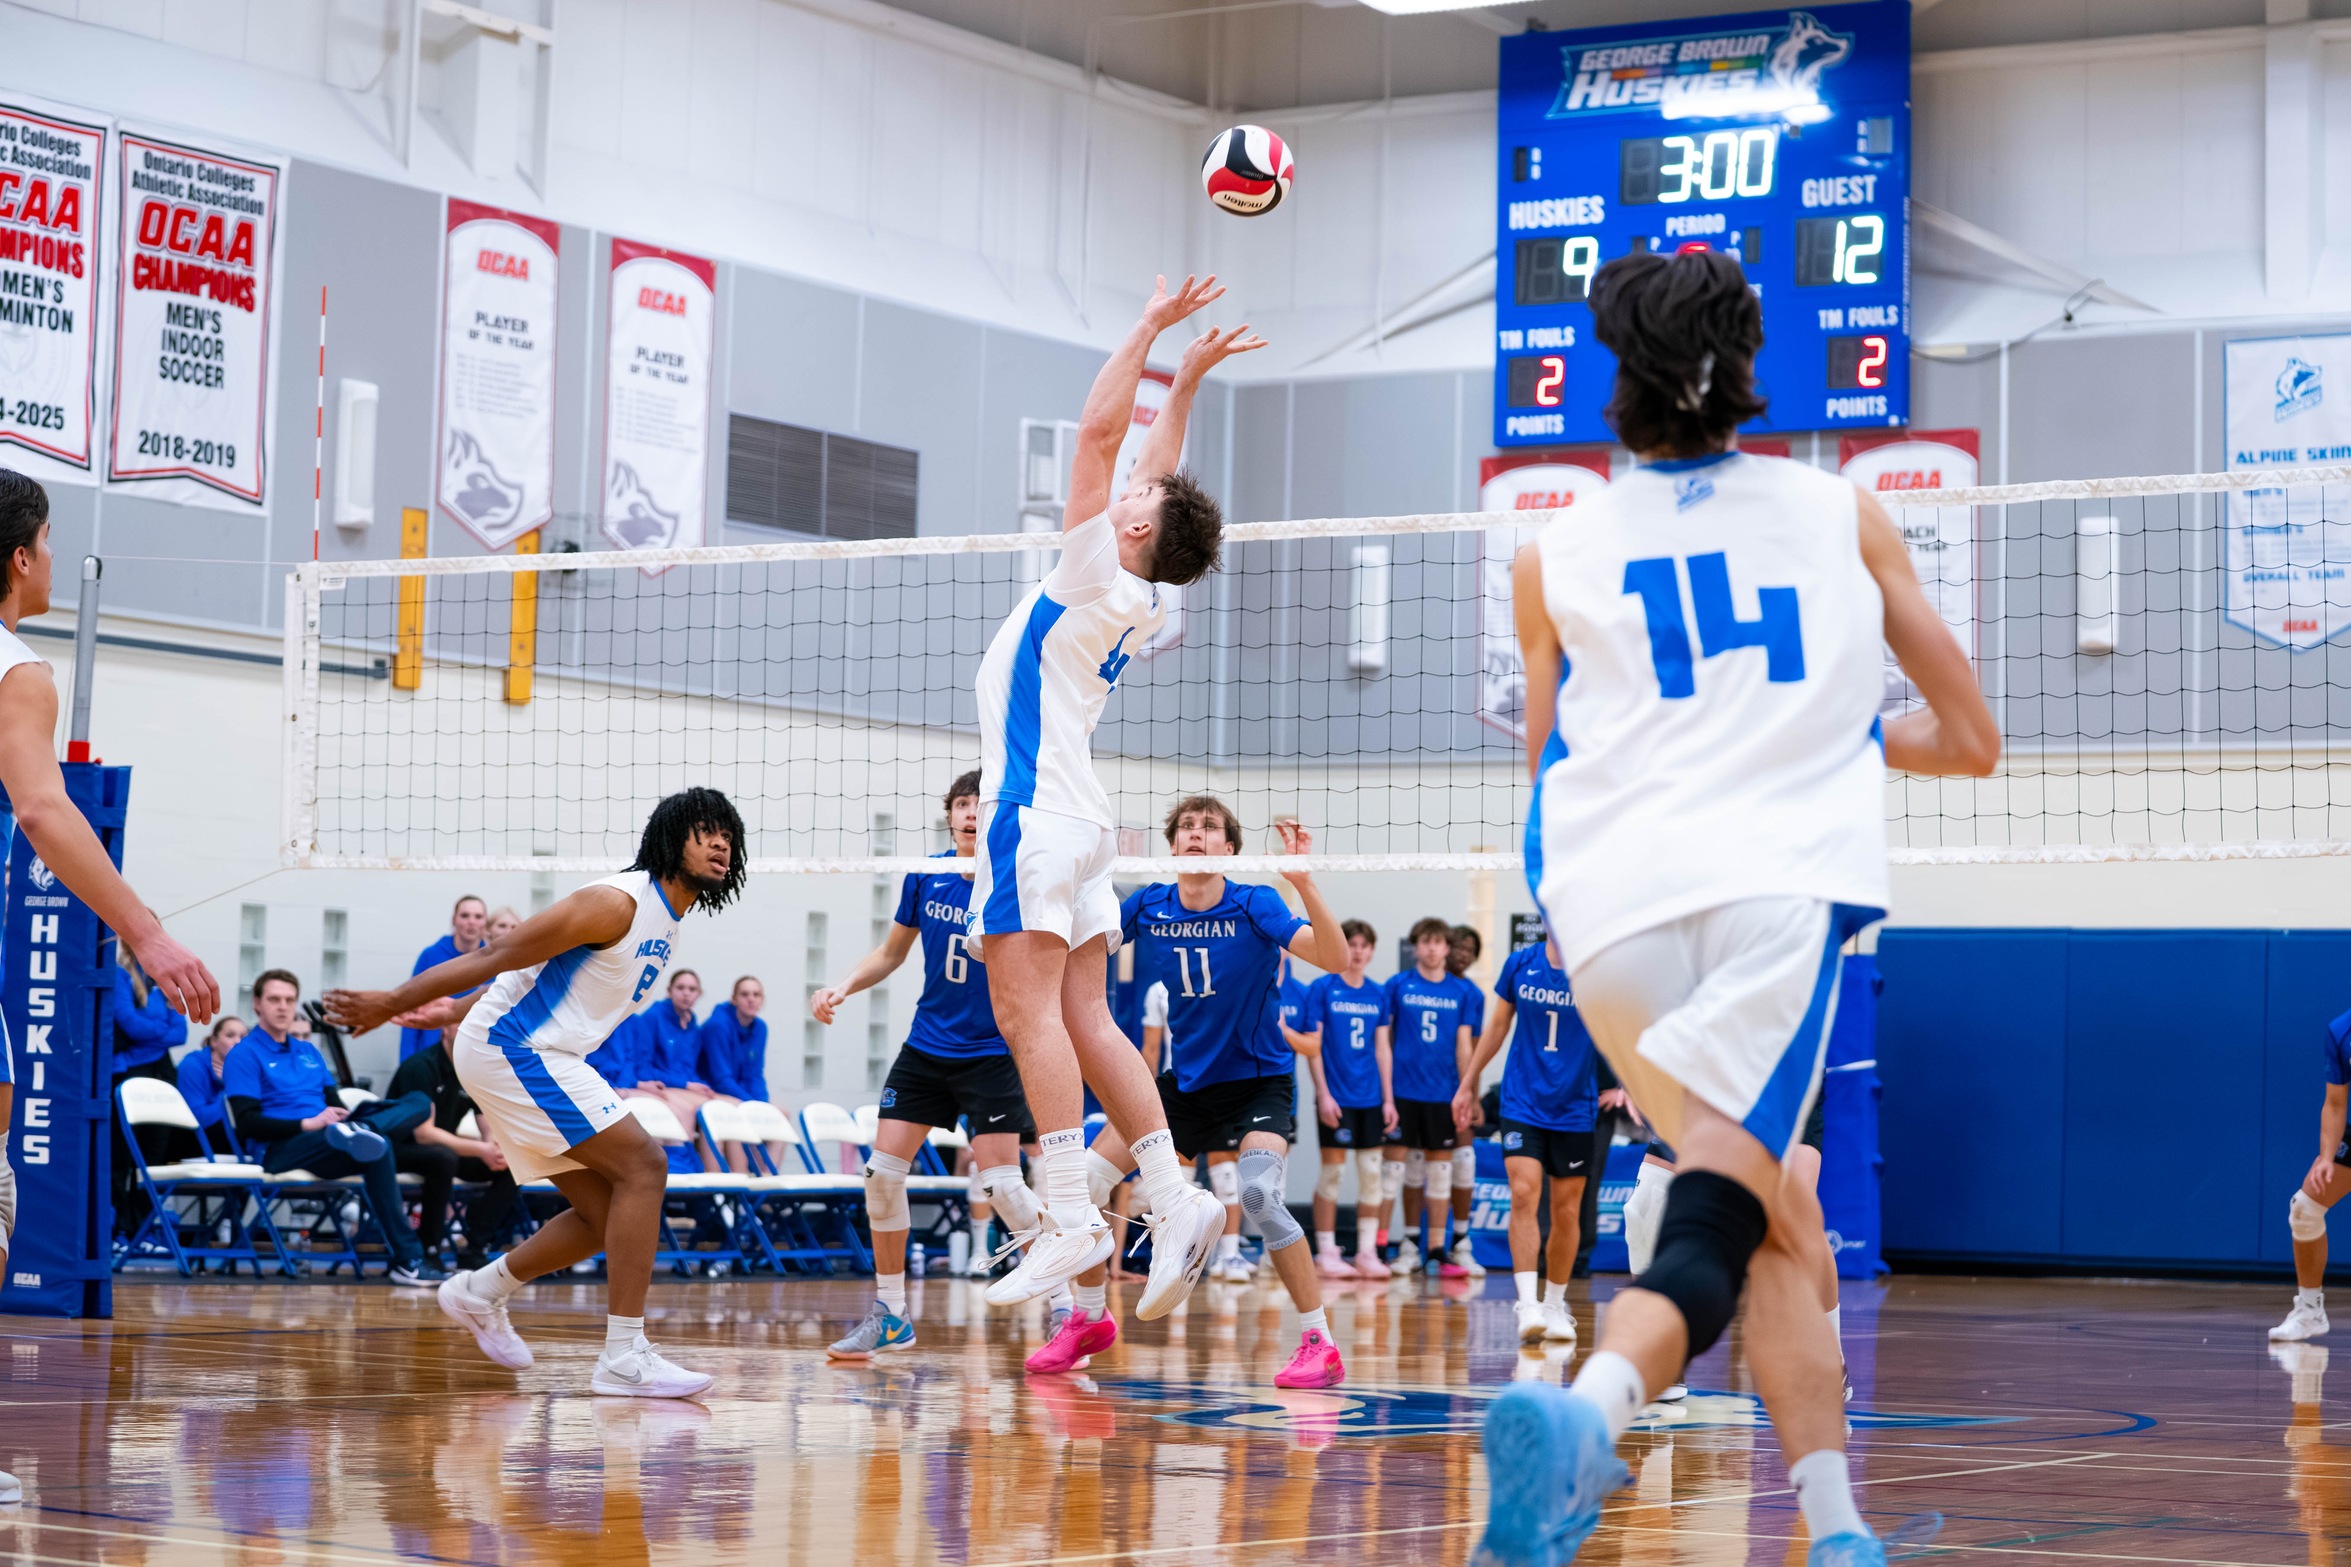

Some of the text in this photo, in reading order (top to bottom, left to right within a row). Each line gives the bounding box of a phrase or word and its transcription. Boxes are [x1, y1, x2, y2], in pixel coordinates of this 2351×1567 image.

[1580, 35, 1770, 71] GEORGE BROWN
[21, 125, 81, 157] Colleges
[11, 145, 91, 180] Association
[144, 151, 256, 193] Ontario Colleges
[1658, 129, 1775, 203] 3:00
[132, 170, 264, 216] Athletic Association
[1223, 194, 1263, 209] molten
[1802, 175, 1877, 208] GUEST
[1509, 195, 1605, 230] HUSKIES
[138, 200, 255, 269] OCAA
[1833, 215, 1884, 284] 12
[477, 249, 529, 282] OCAA
[1563, 236, 1599, 298] 9
[0, 270, 64, 304] MEN'S
[133, 252, 256, 313] CHAMPIONS
[166, 301, 222, 333] MEN'S
[638, 286, 687, 318] OCAA
[1818, 305, 1899, 329] TM FOULS
[476, 310, 529, 333] PLAYER
[1499, 326, 1575, 350] TM FOULS
[162, 329, 224, 362] INDOOR
[637, 346, 685, 368] PLAYER
[1858, 337, 1886, 387] 2
[159, 356, 224, 389] SOCCER
[1536, 357, 1564, 405] 2
[1826, 395, 1887, 418] POINTS
[1507, 414, 1564, 436] POINTS
[138, 430, 236, 468] 2018-2019
[2236, 450, 2298, 464] ALPINE
[1876, 470, 1941, 491] OCAA
[1900, 526, 1935, 539] ACH
[1622, 551, 1805, 698] 14
[1150, 919, 1236, 938] GEORGIAN
[945, 933, 968, 984] 6
[1173, 947, 1217, 998] 11
[23, 914, 58, 1165] HUSKIES
[1350, 1017, 1365, 1049] 2
[1422, 1010, 1437, 1042] 5
[1544, 1010, 1558, 1052] 1
